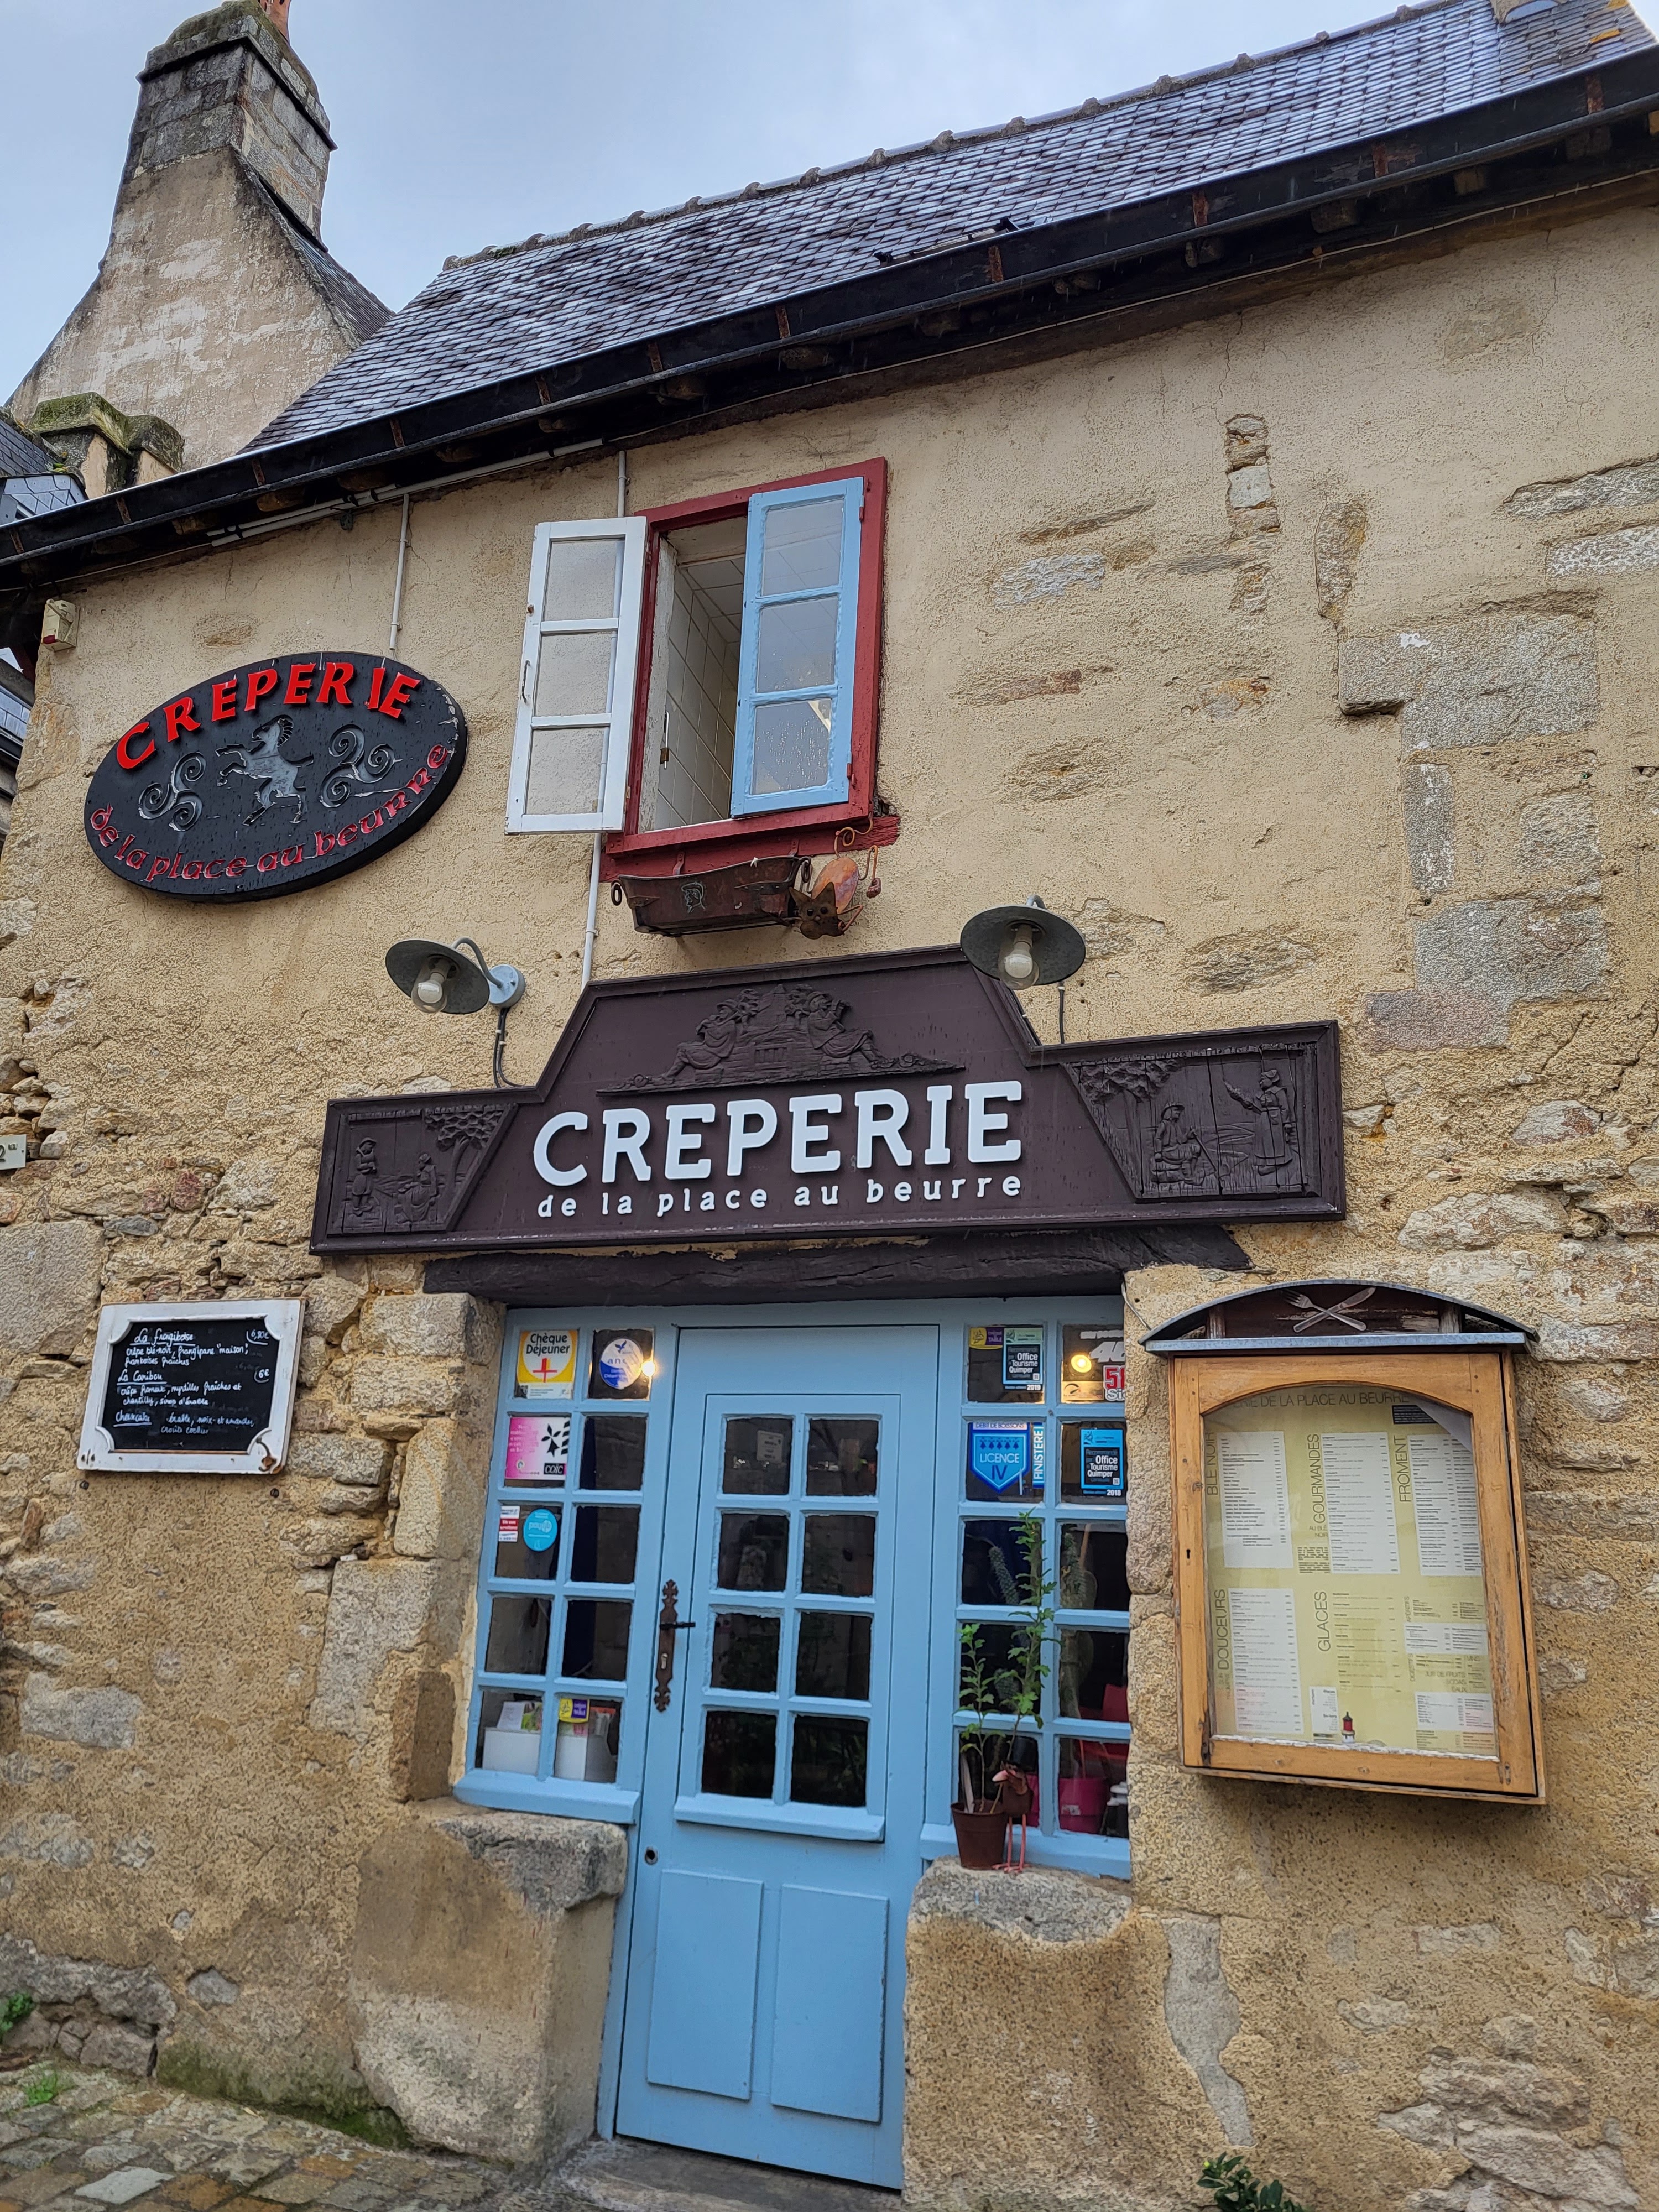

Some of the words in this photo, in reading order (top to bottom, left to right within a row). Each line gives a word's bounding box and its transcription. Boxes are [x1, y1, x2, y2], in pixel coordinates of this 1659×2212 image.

[116, 661, 421, 769] CREPERIE
[91, 803, 119, 847] de
[114, 834, 149, 869] la
[146, 852, 248, 882] place
[257, 844, 304, 873] au
[314, 743, 449, 857] beurre
[533, 1080, 1022, 1187] CREPERIE
[538, 1194, 577, 1218] de
[601, 1193, 633, 1216] la
[656, 1188, 768, 1217] place
[794, 1185, 838, 1206] au
[866, 1176, 1022, 1204] beurre
[530, 1333, 568, 1345] Chèque
[1009, 1366, 1034, 1374] Quimper
[1016, 1352, 1038, 1360] Office
[1261, 1395, 1276, 1407] DE
[1279, 1394, 1295, 1407] LA
[1297, 1393, 1336, 1406] PLACE
[1339, 1393, 1355, 1405] AU
[1359, 1392, 1410, 1404] BEURRE
[979, 1453, 1020, 1464] LICENCE
[1033, 1430, 1044, 1480] FINISTERE
[1089, 1463, 1118, 1471] Tourisme
[1095, 1455, 1118, 1464] Office
[1393, 1435, 1412, 1503] FROMENT
[992, 1464, 1008, 1480] IV
[1087, 1469, 1113, 1478] Quimper
[1307, 1433, 1326, 1524] GOURMANDES
[1214, 1589, 1229, 1670] DOUCEURS
[1313, 1591, 1331, 1652] GLACES
